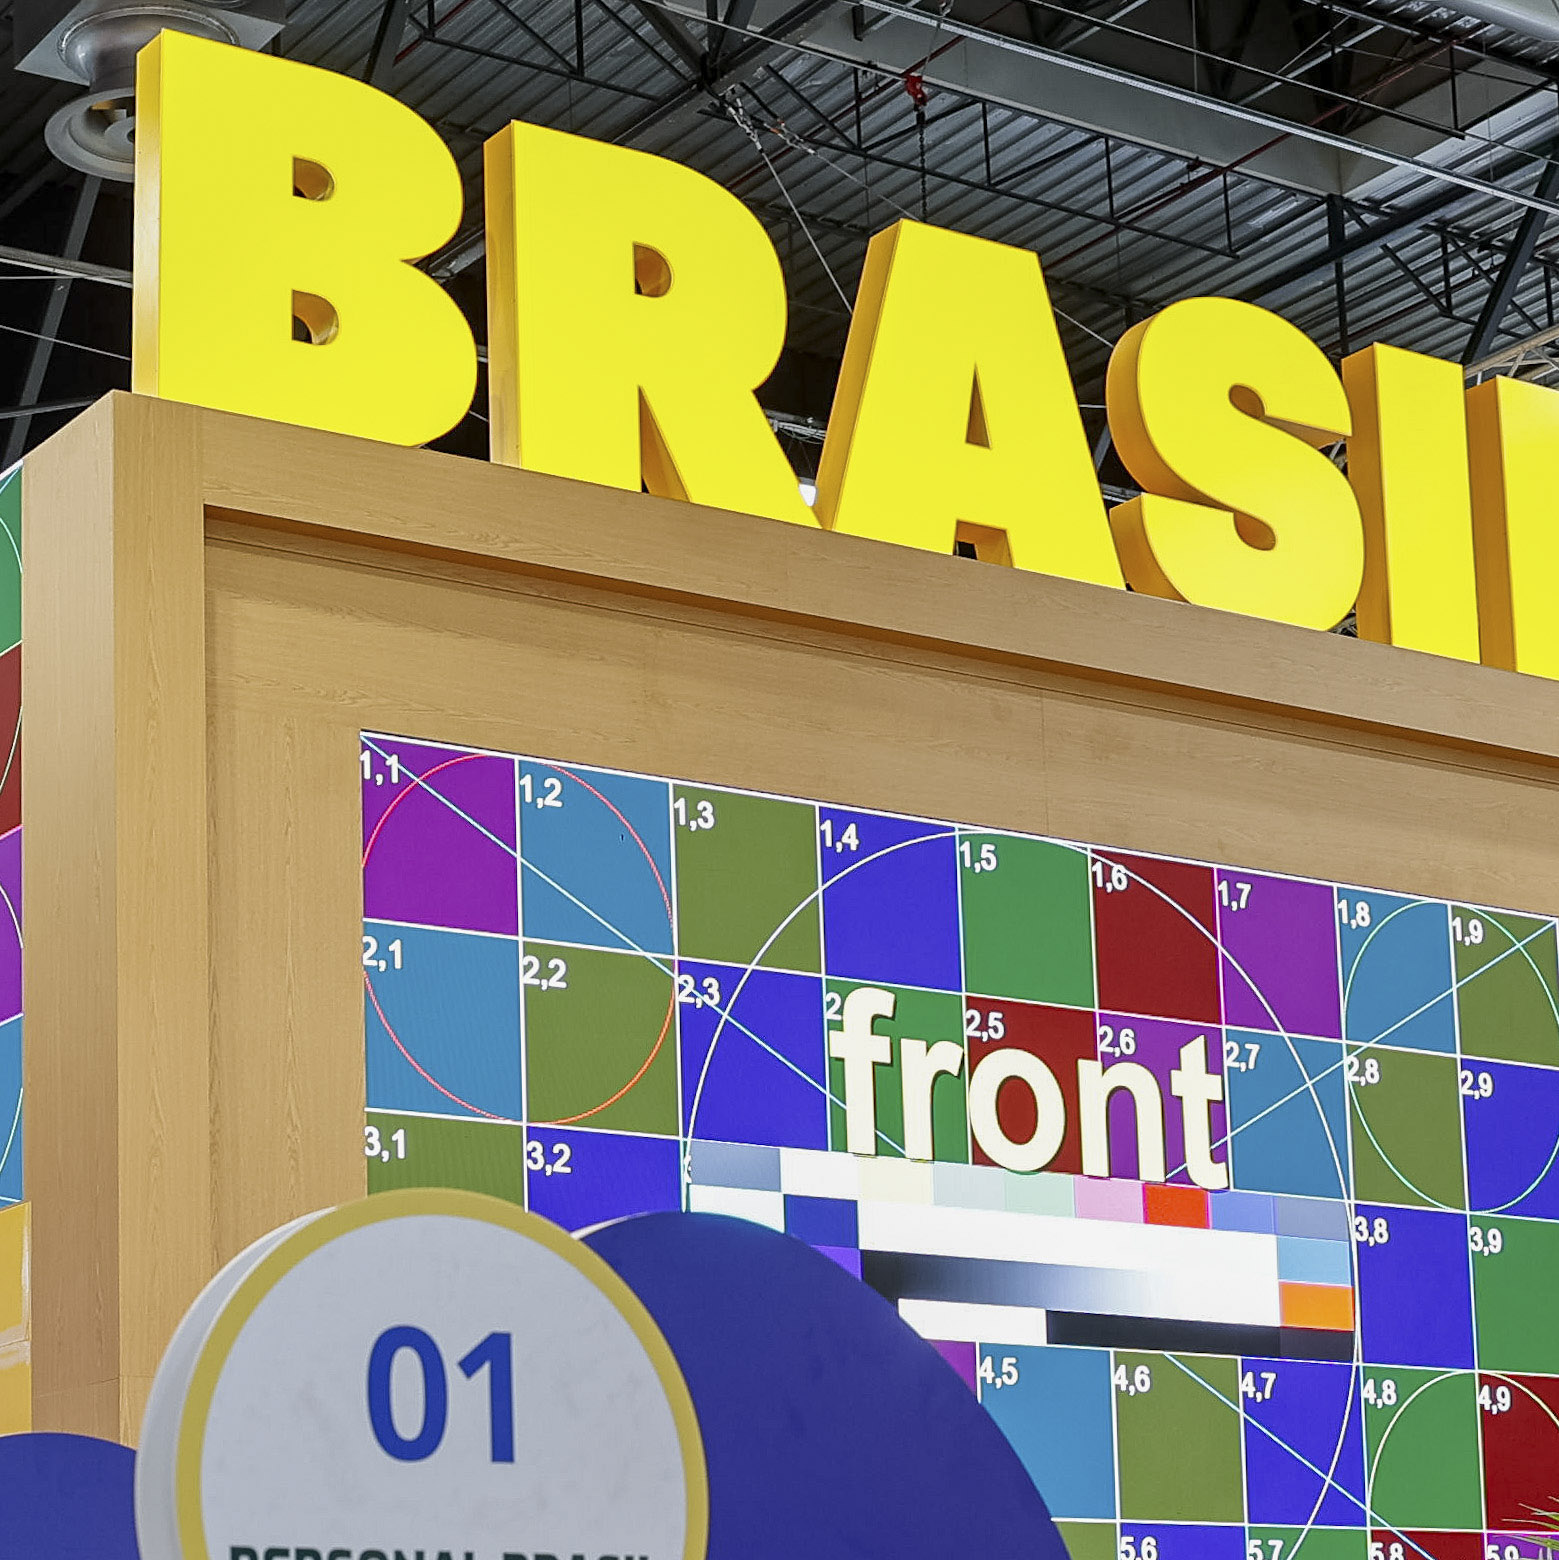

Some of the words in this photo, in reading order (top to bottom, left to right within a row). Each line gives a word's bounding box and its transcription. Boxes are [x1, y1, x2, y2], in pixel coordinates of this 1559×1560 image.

[360, 750, 400, 785] 1,1
[520, 775, 562, 808] 1,2
[674, 798, 715, 830] 1,3
[820, 821, 859, 851] 1,4
[960, 842, 997, 872] 1,5
[1093, 862, 1128, 892] 1,6
[1218, 881, 1251, 910] 1,7
[1338, 899, 1371, 928] 1,8
[1452, 917, 1483, 945] 1,9
[362, 936, 403, 971] 2,1
[523, 957, 567, 991] 2,2
[678, 975, 720, 1008] 2,3
[966, 1010, 1005, 1039] 2,5
[1099, 1027, 1136, 1057] 2,6
[1225, 1043, 1260, 1072] 2,7
[1346, 1057, 1380, 1086] 2,8
[828, 988, 1230, 1190] front
[1461, 1071, 1493, 1098] 2,9
[364, 1126, 407, 1161] 3,1
[527, 1141, 571, 1176] 3,2
[1355, 1216, 1388, 1245] 3,8
[1470, 1227, 1502, 1255] 3,9
[979, 1357, 1019, 1388] 4,5
[1114, 1365, 1151, 1395] 4,6
[1241, 1372, 1276, 1401] 4,7
[367, 1325, 515, 1463] 01
[1363, 1379, 1397, 1408] 4,8
[1477, 1385, 1512, 1414] 4,9
